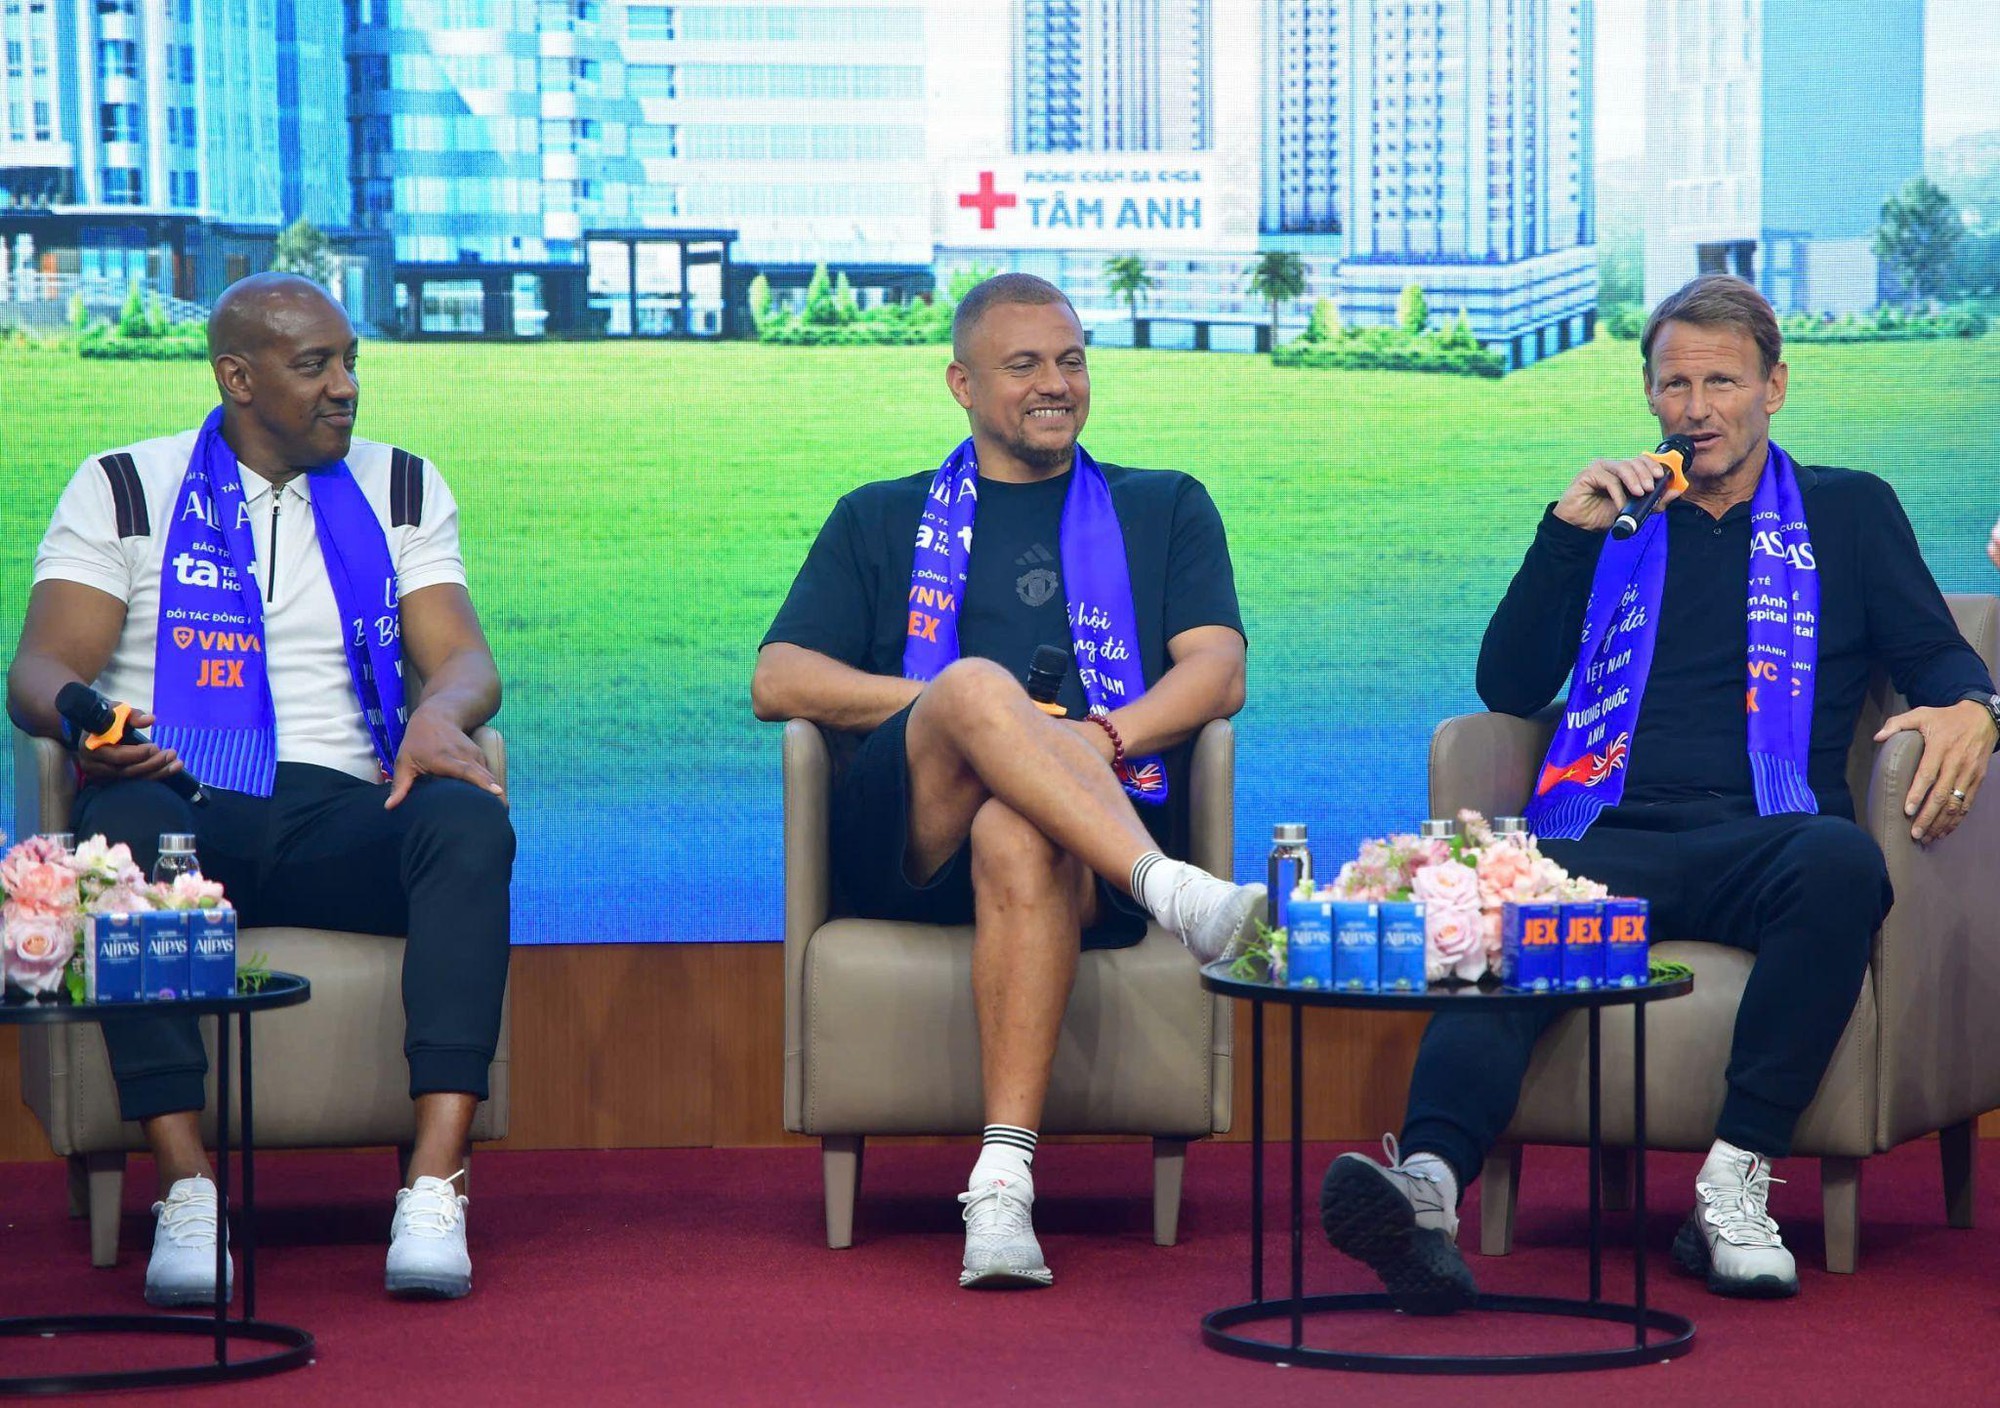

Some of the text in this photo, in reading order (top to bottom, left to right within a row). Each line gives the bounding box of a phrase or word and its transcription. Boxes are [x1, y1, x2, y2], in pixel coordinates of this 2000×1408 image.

[1026, 190, 1202, 229] TÂM ANH
[172, 552, 219, 588] ta
[1760, 594, 1788, 609] Anh
[196, 659, 245, 688] JEX
[1607, 648, 1632, 674] NAM
[1586, 722, 1606, 748] ANH
[1522, 918, 1559, 945] JEX
[1566, 917, 1603, 944] JEX
[1609, 915, 1646, 943] JEX
